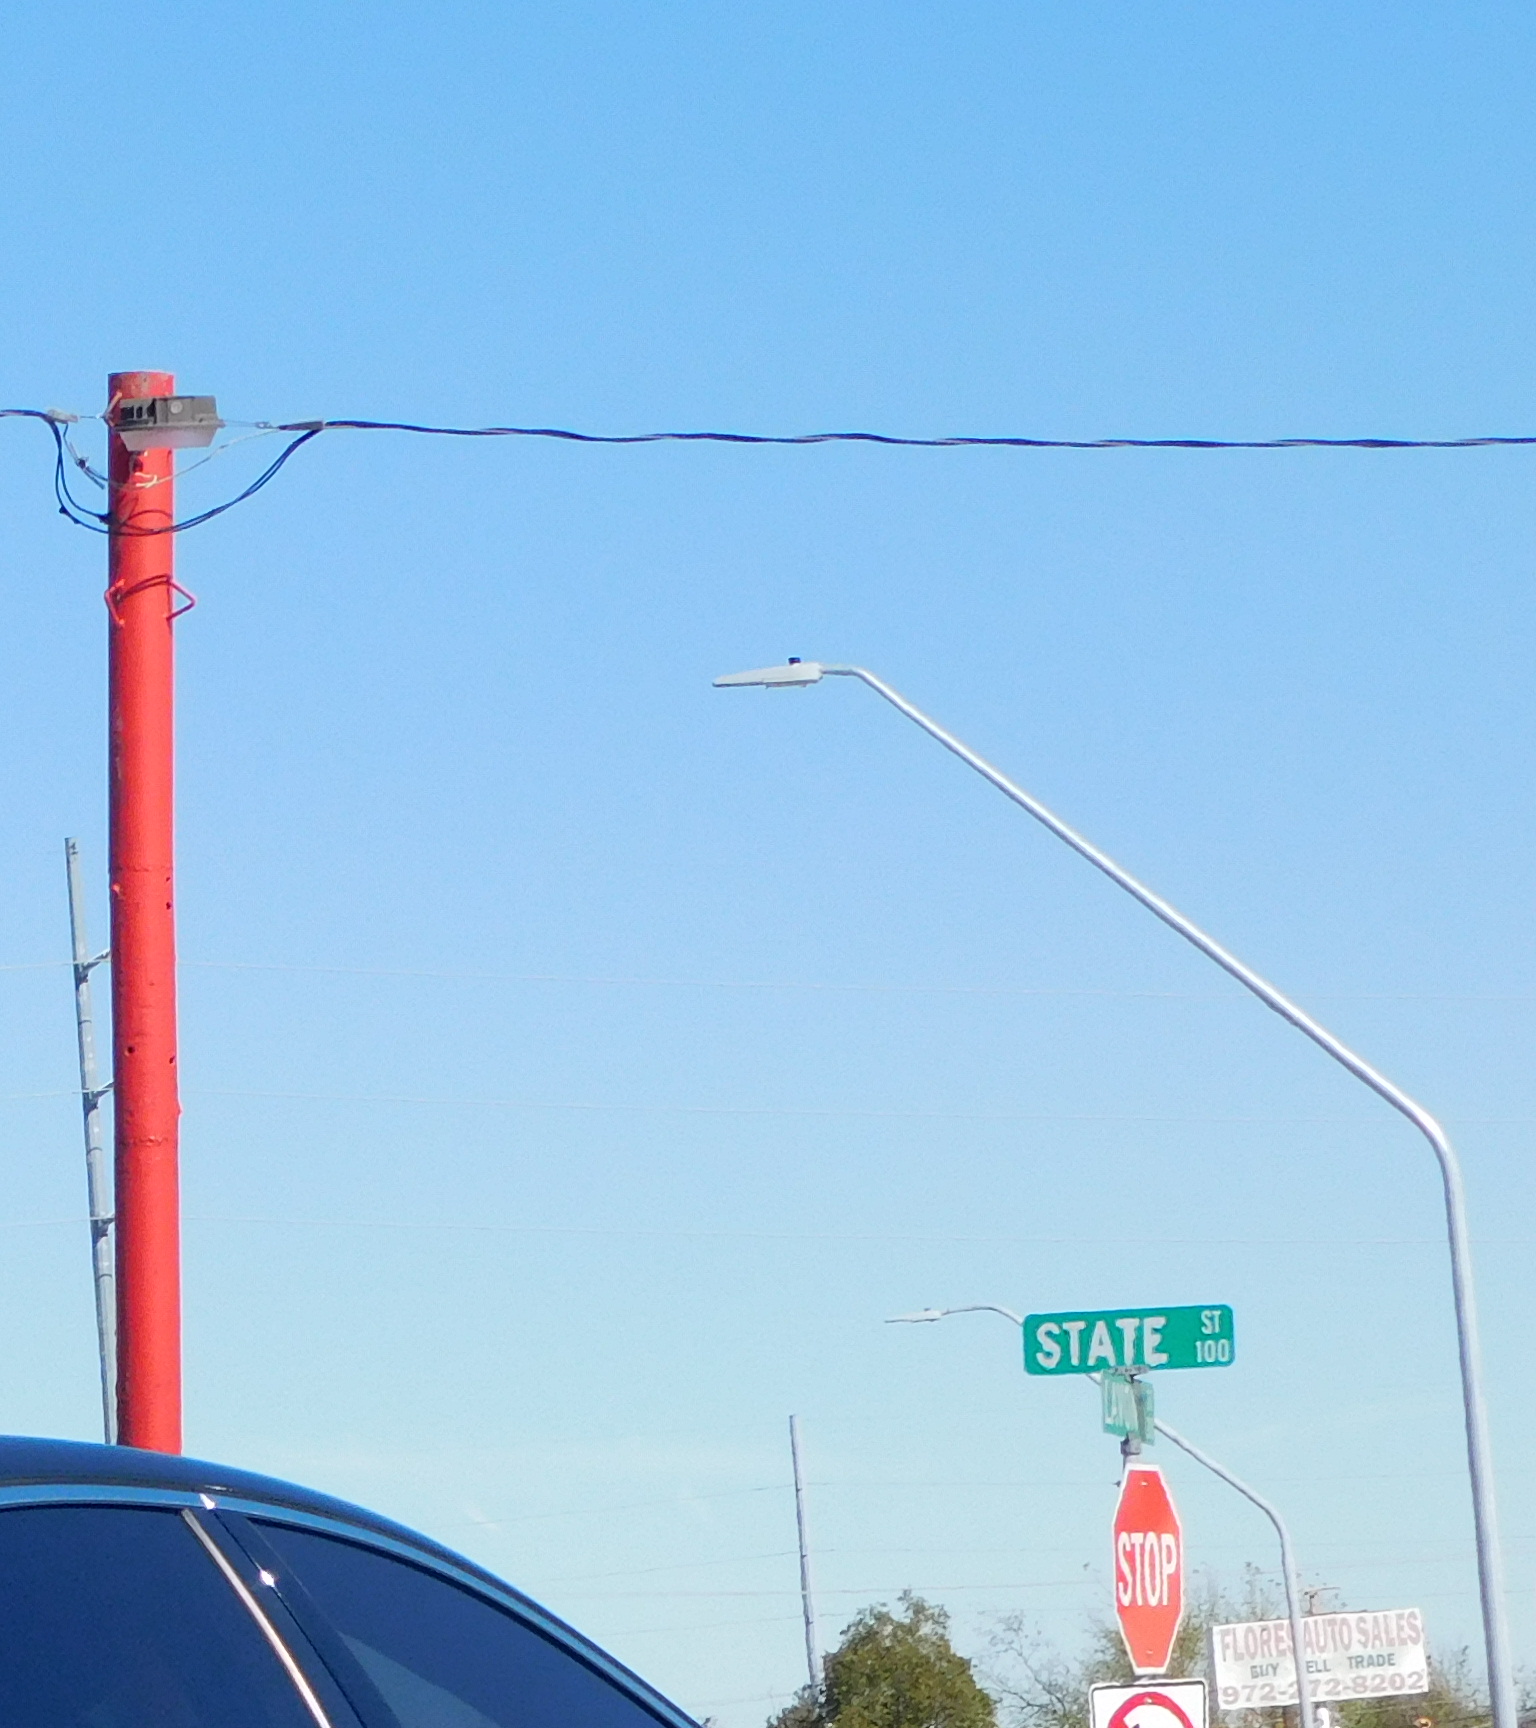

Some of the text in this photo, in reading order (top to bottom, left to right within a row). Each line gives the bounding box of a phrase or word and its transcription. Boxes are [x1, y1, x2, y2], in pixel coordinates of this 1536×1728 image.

[1035, 1310, 1222, 1370] STATE ST
[1195, 1338, 1230, 1363] 100
[1117, 1531, 1177, 1607] STOP
[1303, 1617, 1353, 1655] AUTO
[1356, 1611, 1422, 1650] SALES
[1250, 1653, 1396, 1679] BUY ELL TRADE
